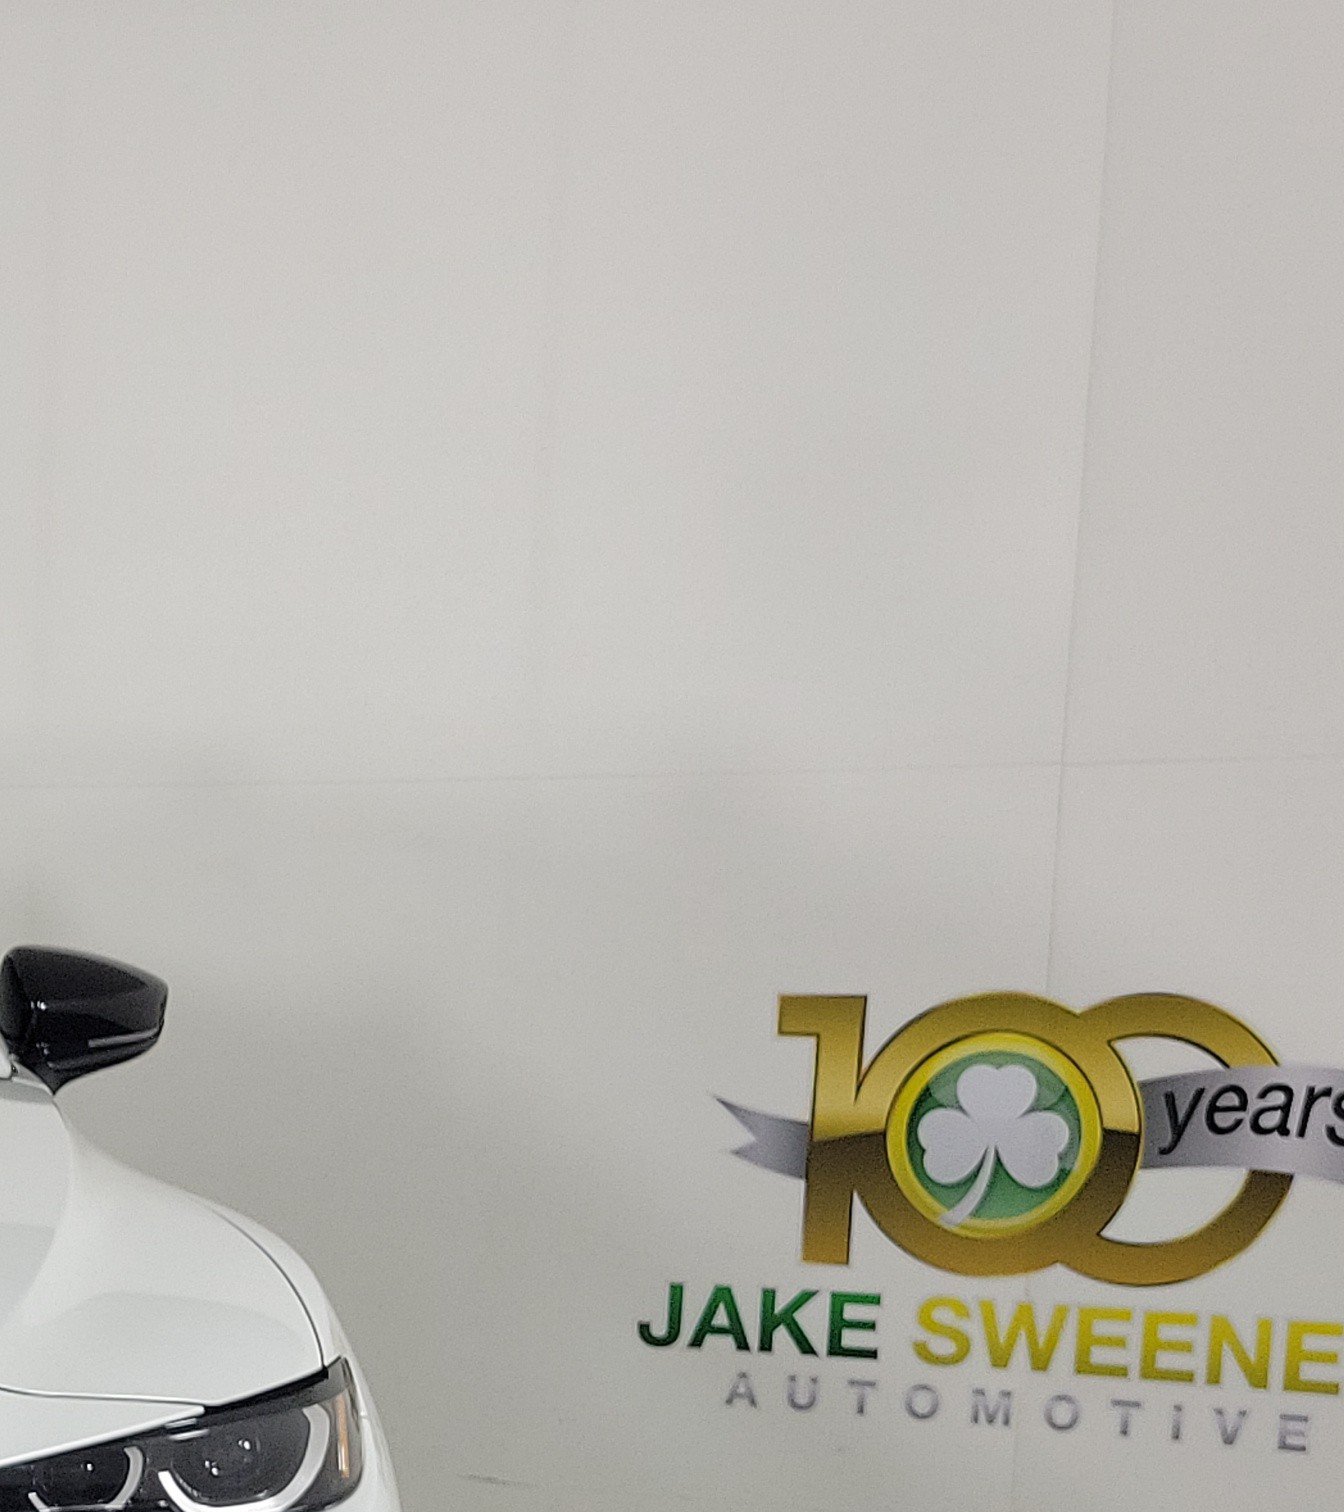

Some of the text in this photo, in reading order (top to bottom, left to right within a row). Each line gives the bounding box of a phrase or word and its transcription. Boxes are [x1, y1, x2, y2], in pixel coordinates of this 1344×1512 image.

[777, 991, 1293, 1287] 100
[637, 1283, 882, 1361] JAKE
[724, 1371, 1309, 1452] AUTOMOTIVE
